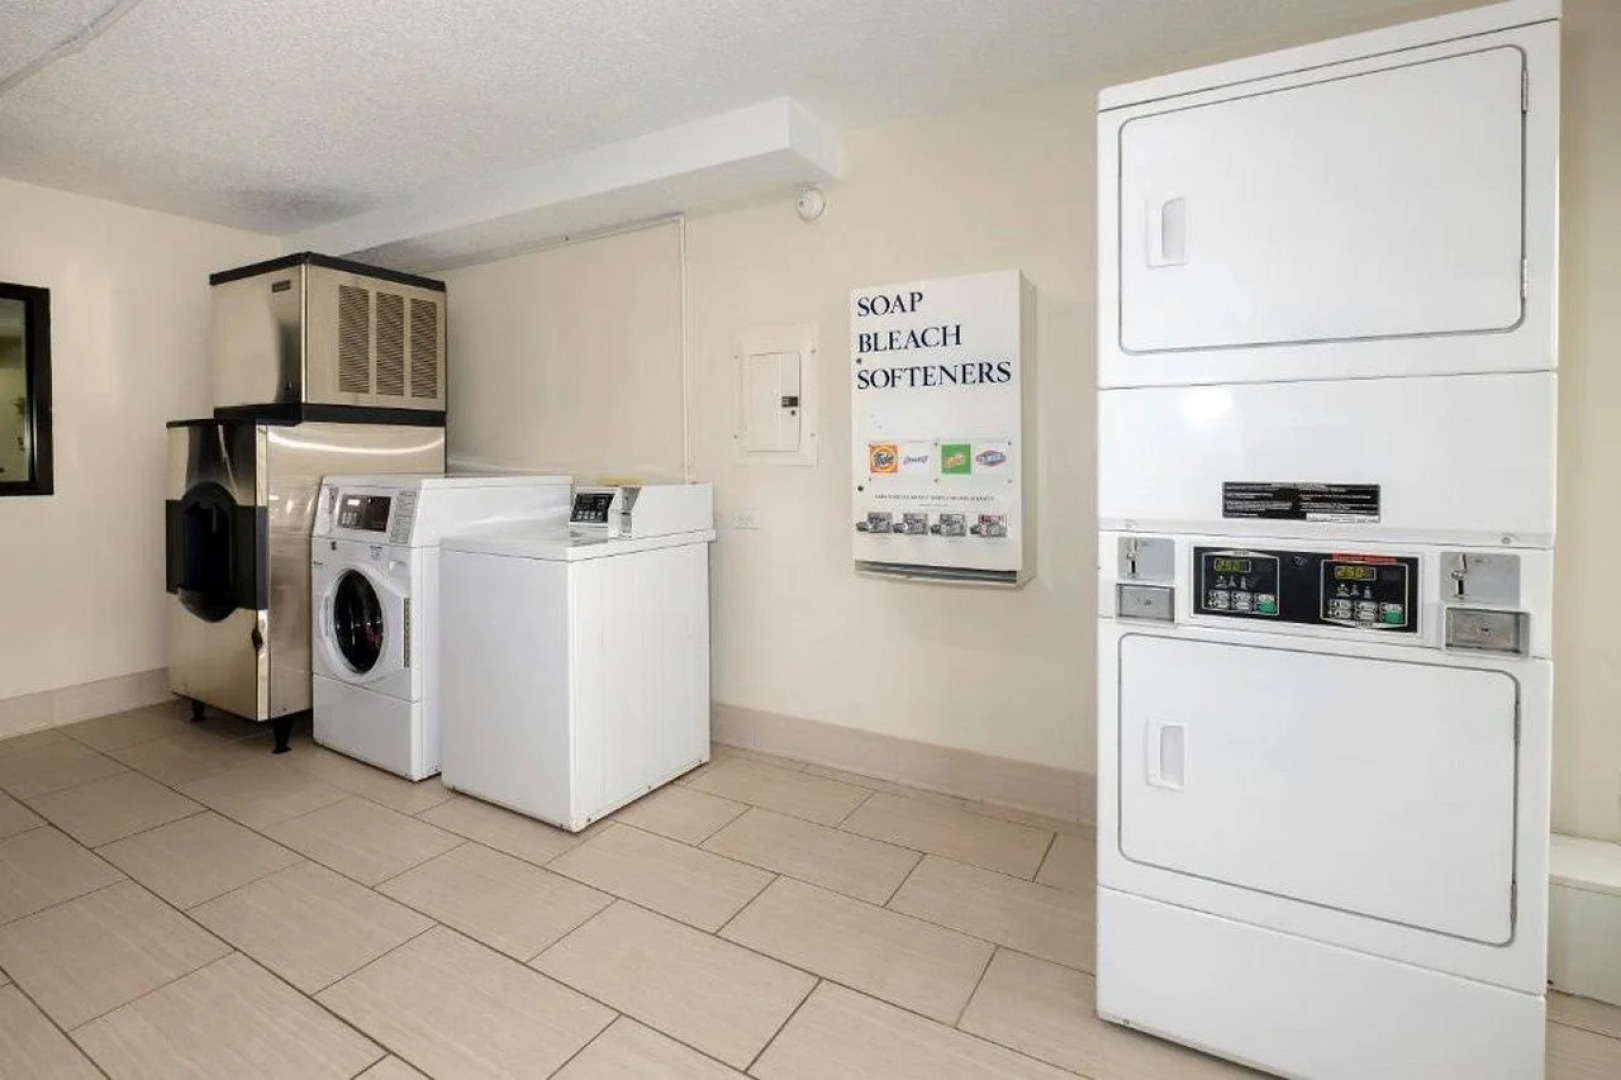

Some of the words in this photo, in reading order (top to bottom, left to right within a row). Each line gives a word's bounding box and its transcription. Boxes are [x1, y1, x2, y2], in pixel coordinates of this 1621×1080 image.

[857, 291, 923, 317] SOAP
[858, 324, 962, 353] BLEACH
[857, 361, 1012, 390] SOFTENERS
